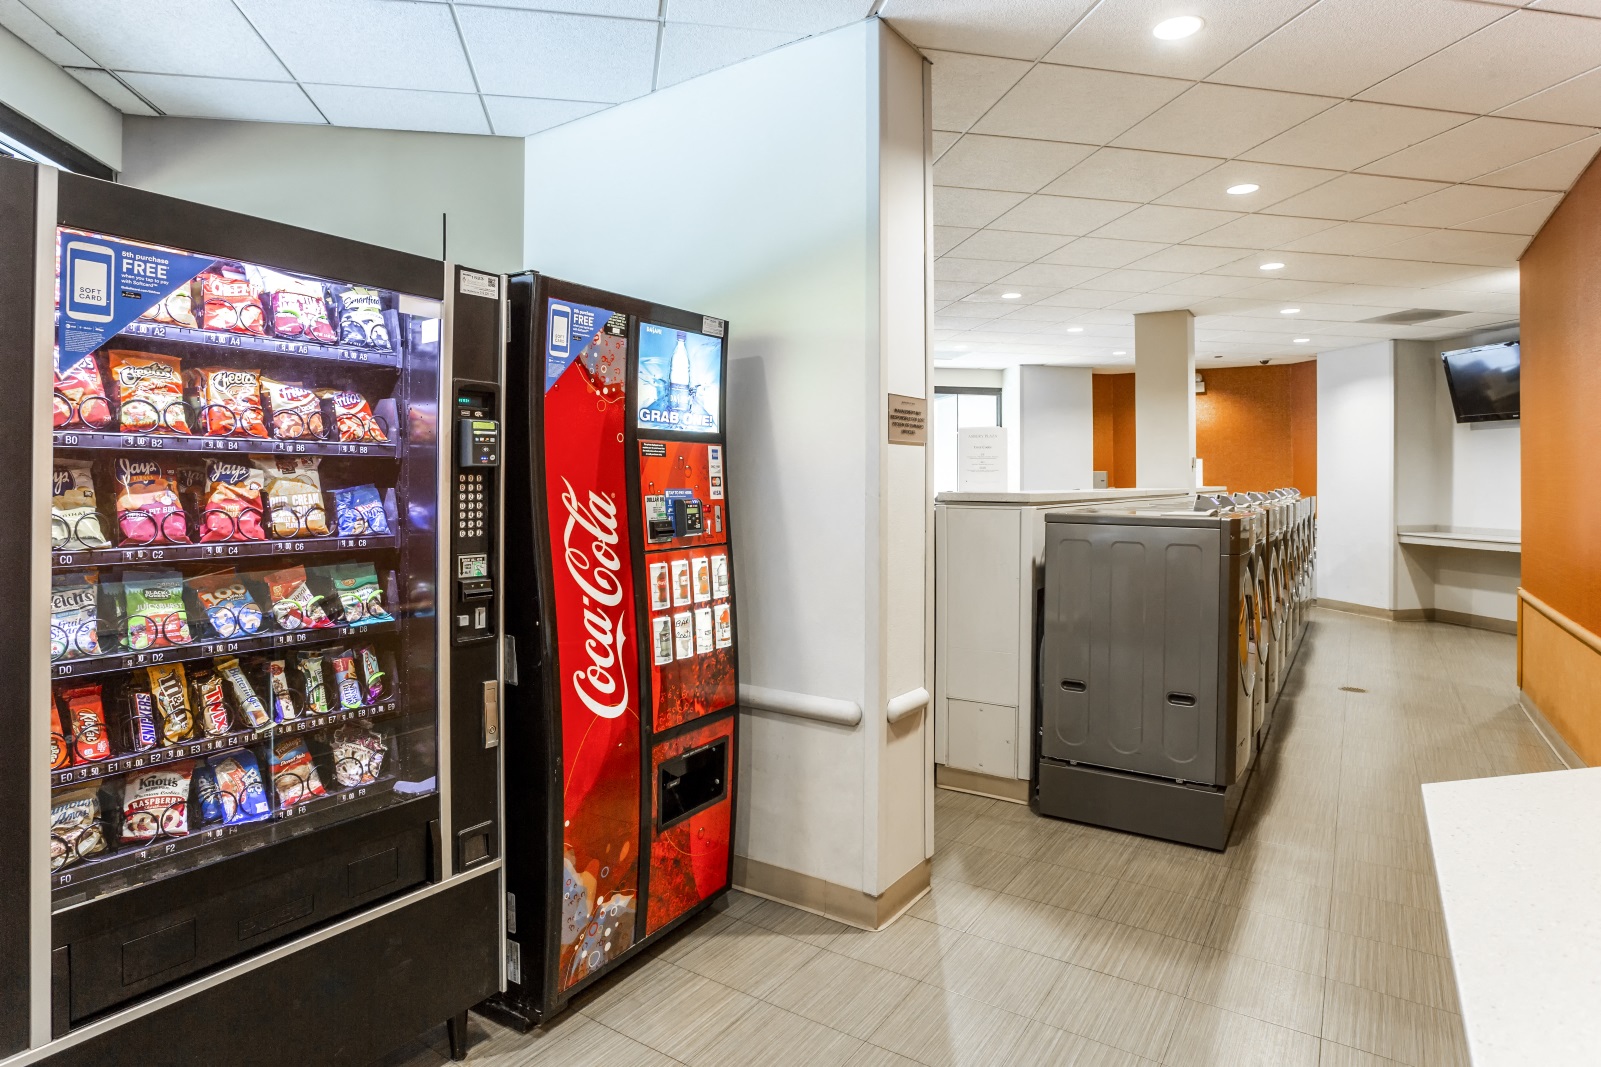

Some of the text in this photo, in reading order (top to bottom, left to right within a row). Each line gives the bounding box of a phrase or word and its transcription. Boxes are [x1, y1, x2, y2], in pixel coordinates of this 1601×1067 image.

[136, 254, 169, 265] purchase
[122, 259, 168, 280] FREE
[79, 286, 102, 295] SOFT
[78, 293, 103, 302] CARD
[573, 313, 595, 327] FREE
[153, 326, 165, 335] A2
[230, 336, 240, 345] A4
[639, 407, 714, 428] GRAB ONE!
[64, 435, 77, 446] B0
[150, 438, 163, 448] B2
[228, 442, 238, 451] B4
[296, 444, 304, 452] B6
[359, 446, 368, 454] B8
[291, 493, 320, 506] CREAM
[295, 543, 304, 552] C6
[358, 540, 367, 548] C8
[151, 550, 164, 560] C2
[228, 546, 238, 555] C4
[59, 555, 72, 564] C0
[52, 589, 97, 610] elch's
[201, 583, 247, 606] ZOO
[559, 474, 629, 720] Coca-Cola
[296, 634, 306, 643] D6
[227, 643, 238, 652] D4
[150, 653, 164, 663] D2
[59, 664, 72, 674] D0
[135, 692, 156, 744] SNICKERS
[357, 709, 366, 718] E8
[327, 715, 336, 724] E7
[296, 722, 305, 731] E6
[227, 735, 237, 745] E4
[189, 744, 200, 754] E3
[149, 754, 160, 764] E2
[107, 763, 118, 773] E1
[60, 772, 72, 783] E0
[138, 775, 179, 791] Knott's
[356, 789, 366, 797] F8
[132, 797, 184, 809] RASPBERRY
[297, 805, 306, 814] F6
[228, 827, 238, 836] F4
[164, 843, 176, 853] F2
[59, 874, 71, 884] F0
